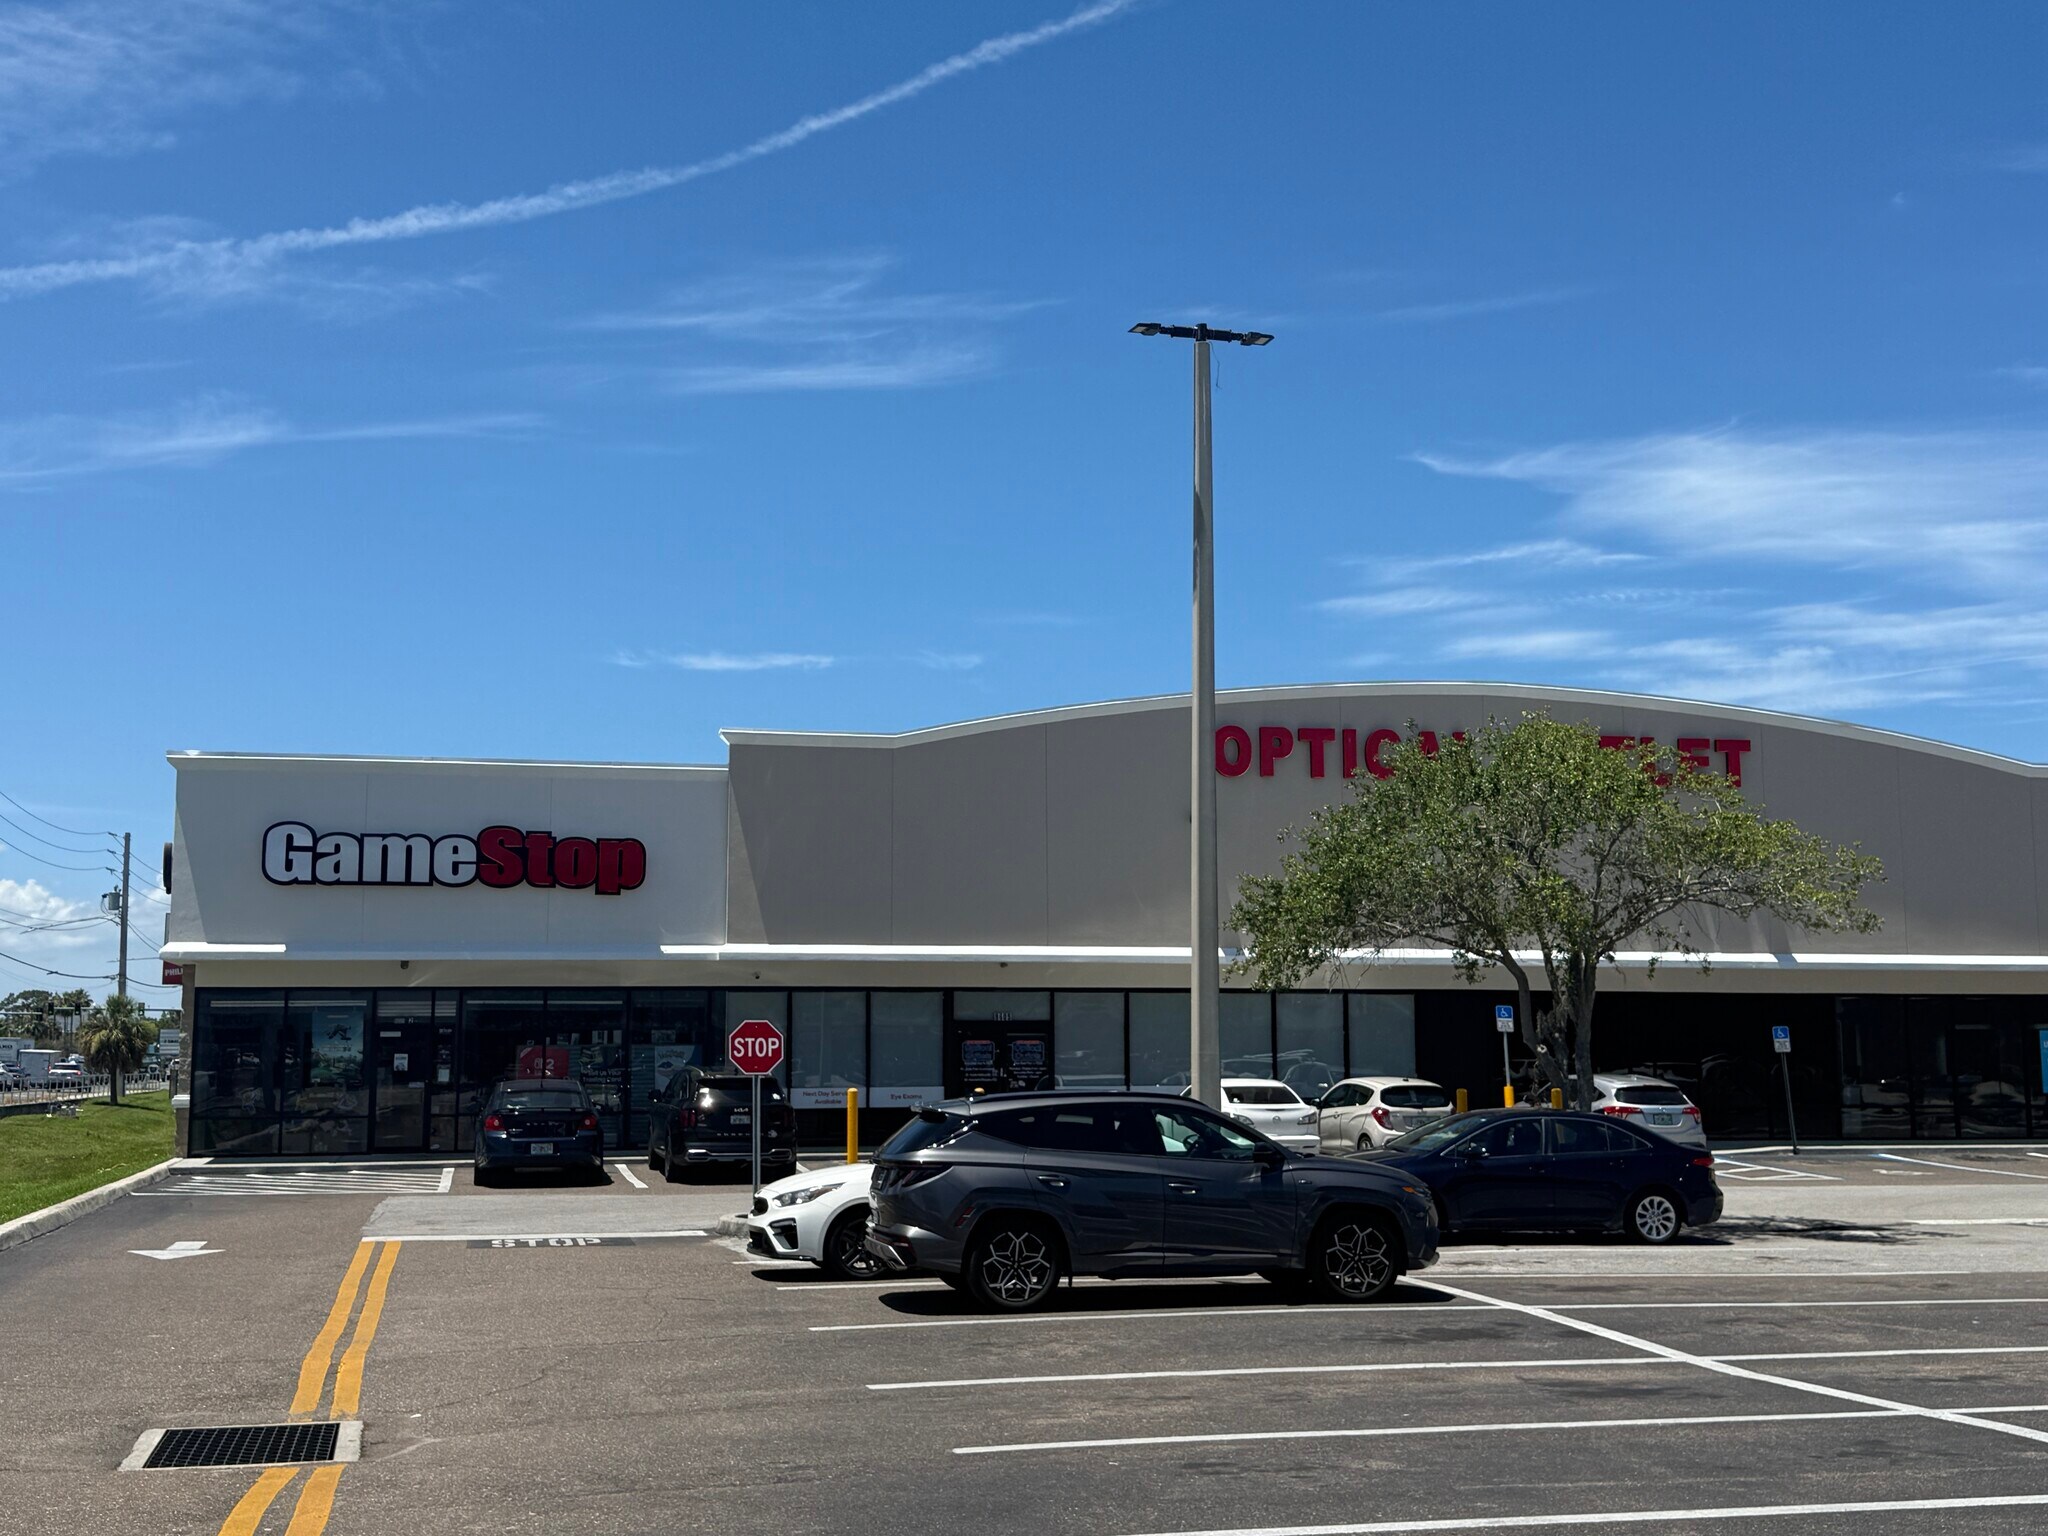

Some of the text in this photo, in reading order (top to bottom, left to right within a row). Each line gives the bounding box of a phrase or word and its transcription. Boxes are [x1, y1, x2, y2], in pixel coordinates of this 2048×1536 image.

[1214, 725, 1466, 780] OPTICA
[261, 820, 647, 895] GameStop
[733, 1037, 780, 1058] STOP
[491, 1237, 602, 1248] STOP
